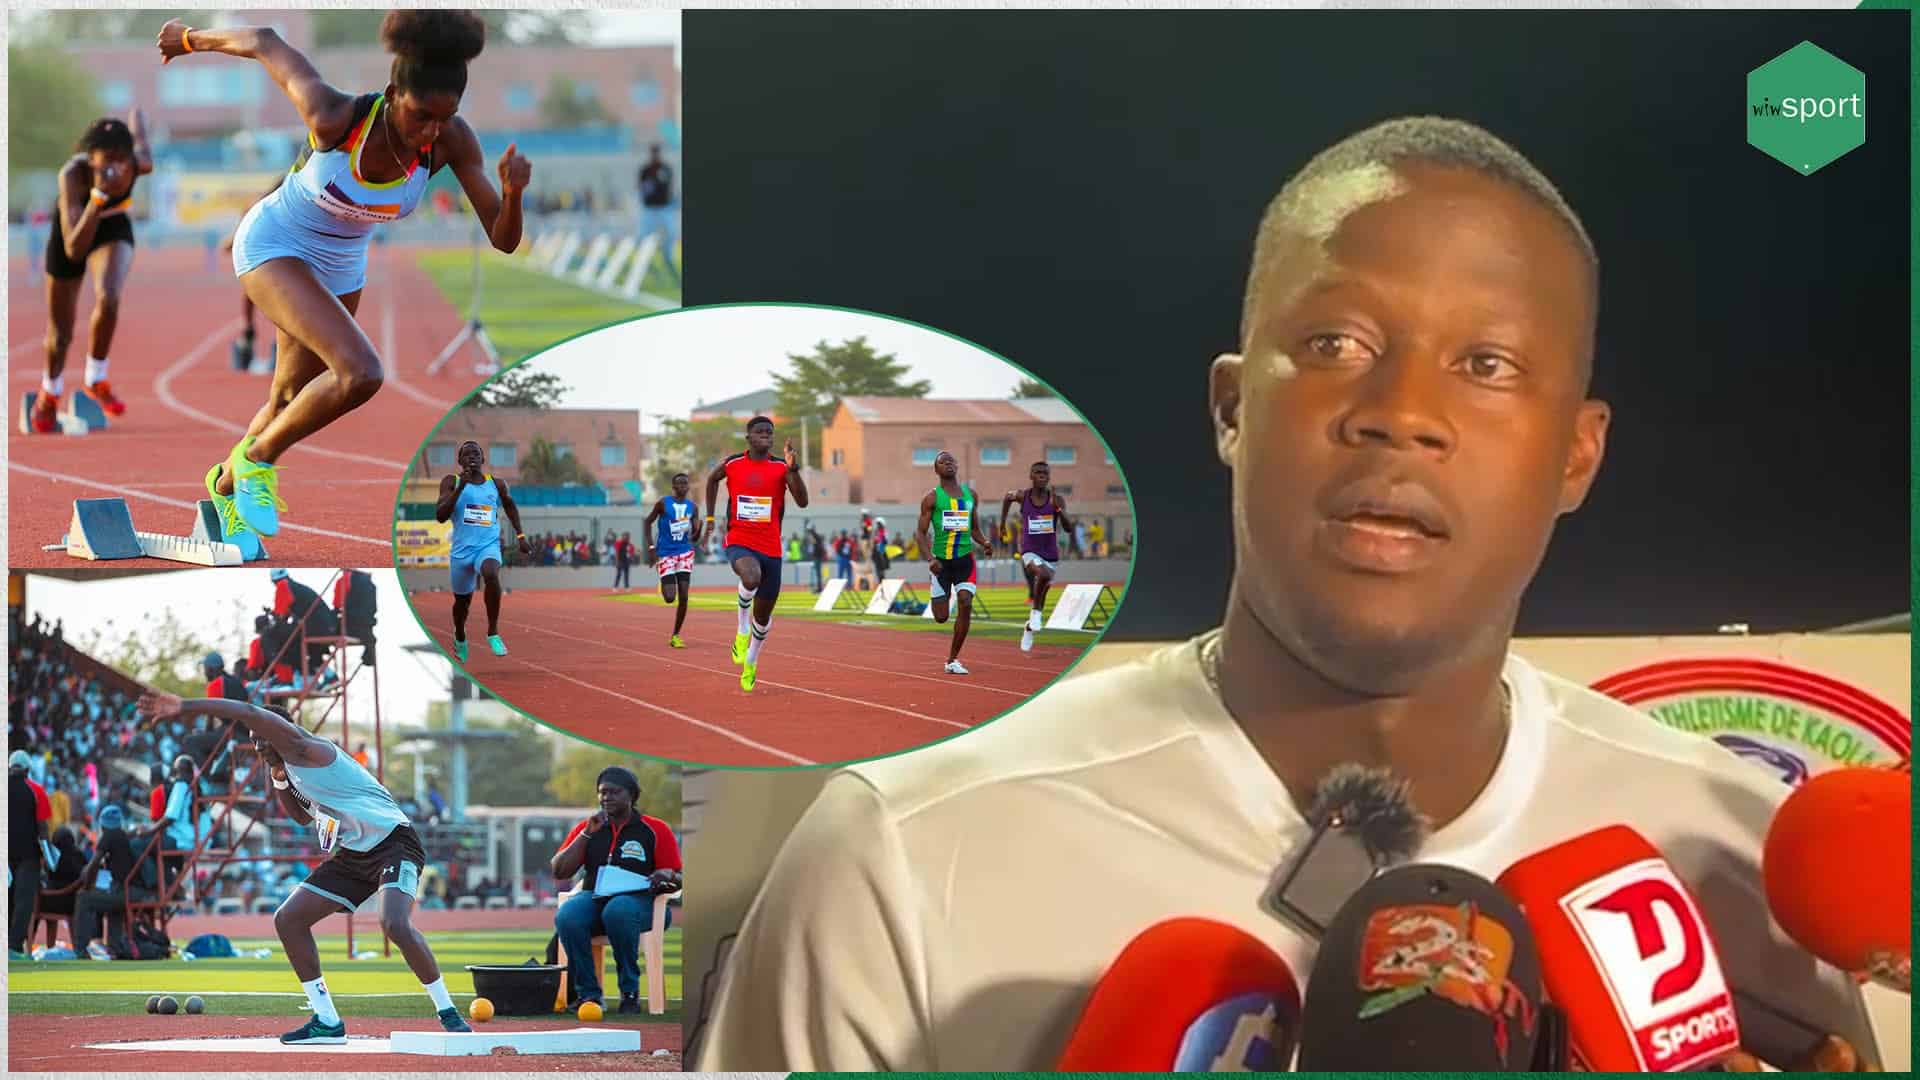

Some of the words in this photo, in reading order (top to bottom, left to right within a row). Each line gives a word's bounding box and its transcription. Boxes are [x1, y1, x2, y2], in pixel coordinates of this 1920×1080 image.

[1649, 697, 1765, 731] THLETISME
[1771, 704, 1799, 738] DE
[1651, 1007, 1736, 1060] SPORTS
